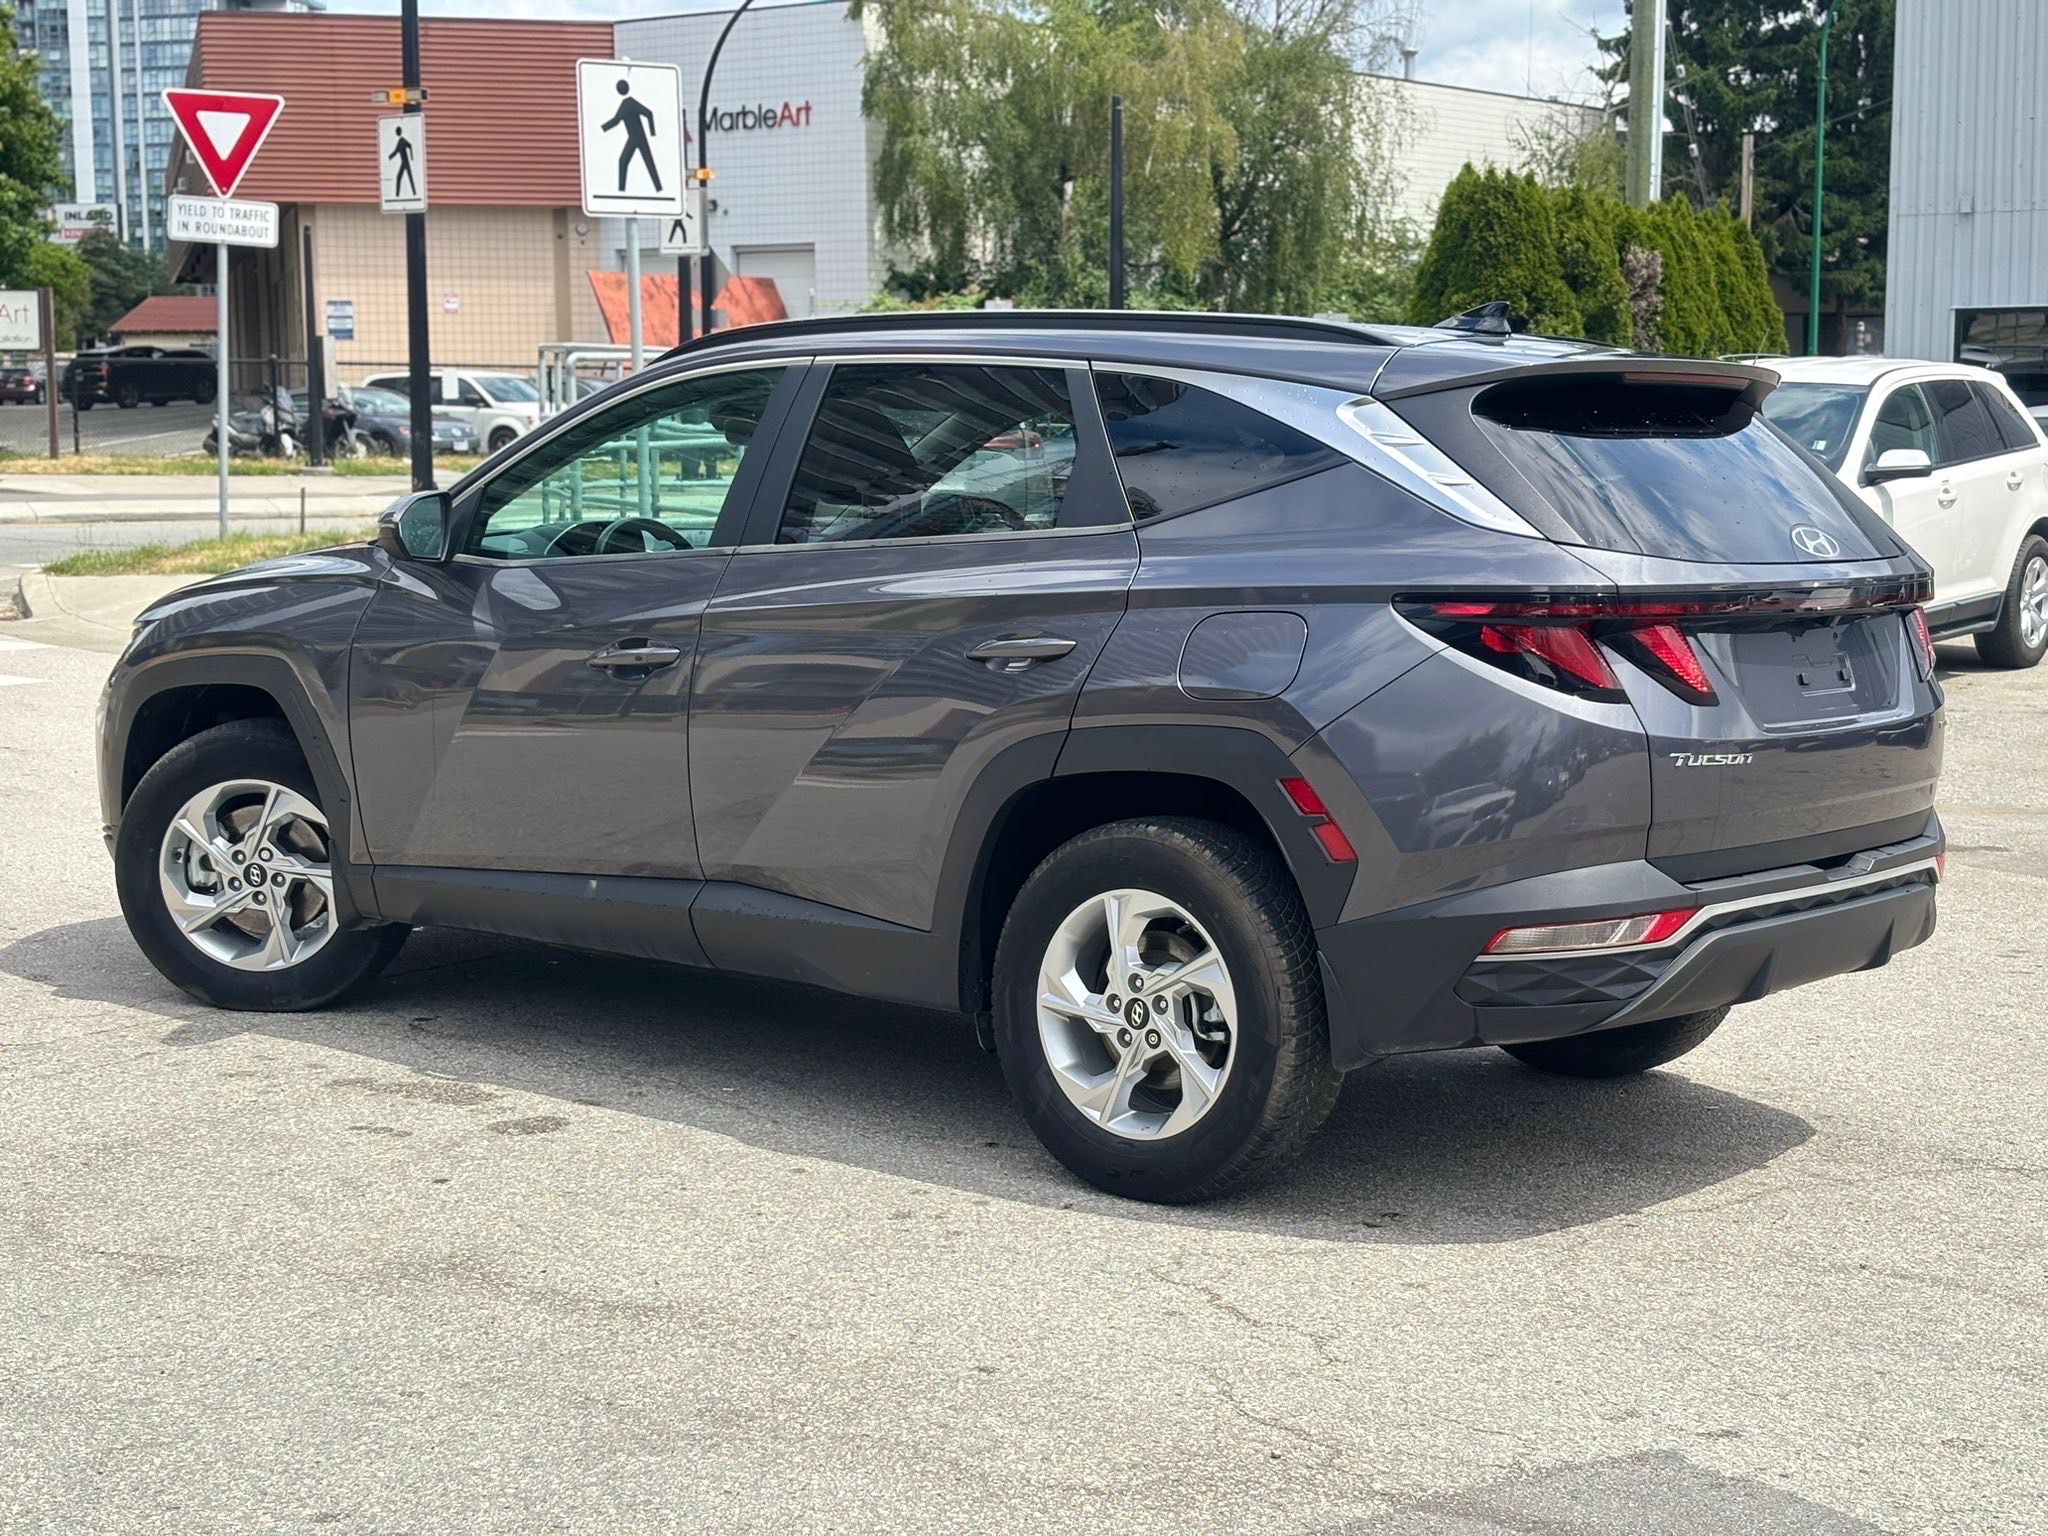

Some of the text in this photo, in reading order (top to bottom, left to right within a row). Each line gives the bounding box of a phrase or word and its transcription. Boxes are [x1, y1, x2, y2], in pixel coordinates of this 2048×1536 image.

[64, 211, 113, 221] INLD
[177, 203, 271, 222] YIELD TO TRAFFIC
[177, 221, 269, 239] IN ROUNDABOUT
